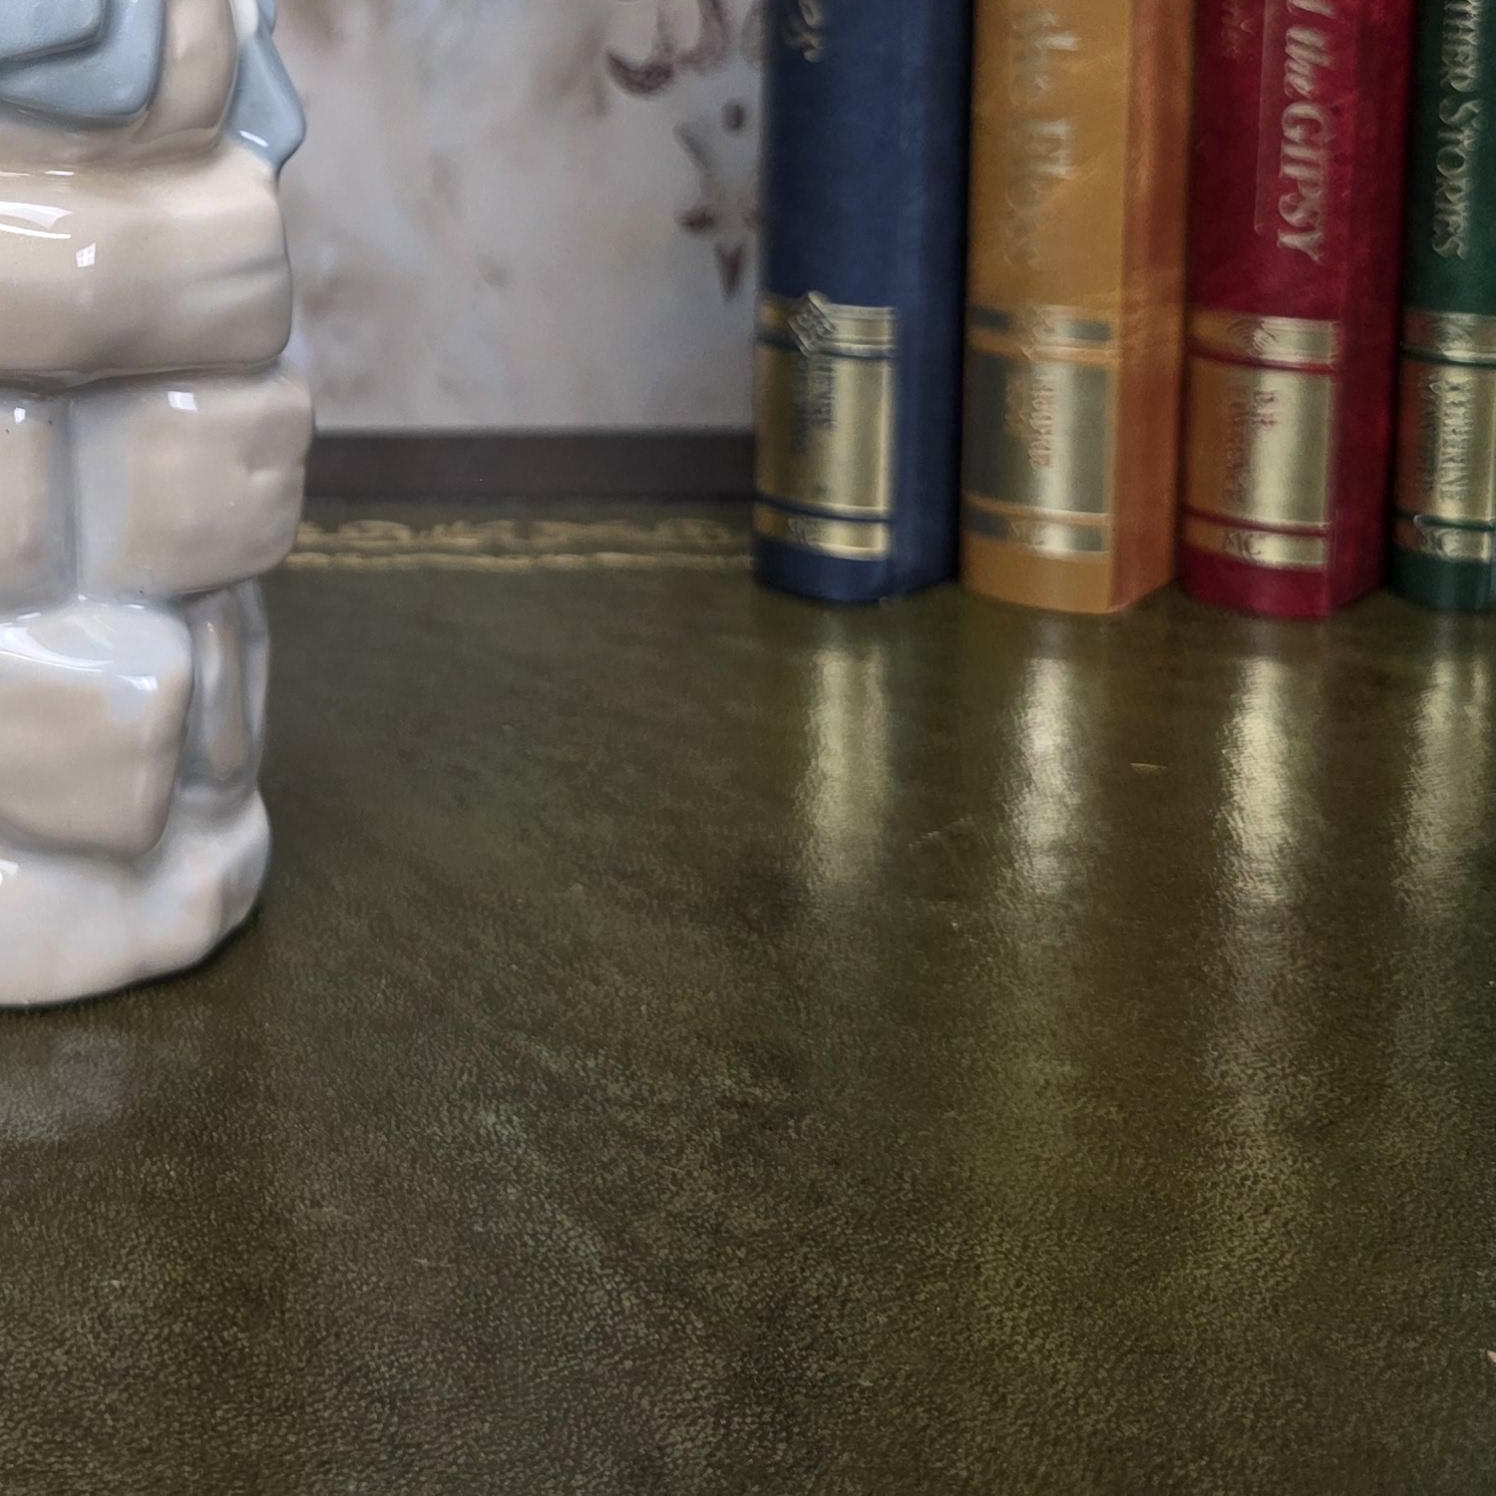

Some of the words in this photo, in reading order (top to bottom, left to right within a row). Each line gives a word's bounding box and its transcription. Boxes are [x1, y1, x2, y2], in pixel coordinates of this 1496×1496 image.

[1283, 25, 1334, 99] the
[1276, 102, 1334, 266] GIPSY
[1431, 96, 1483, 261] STORIES
